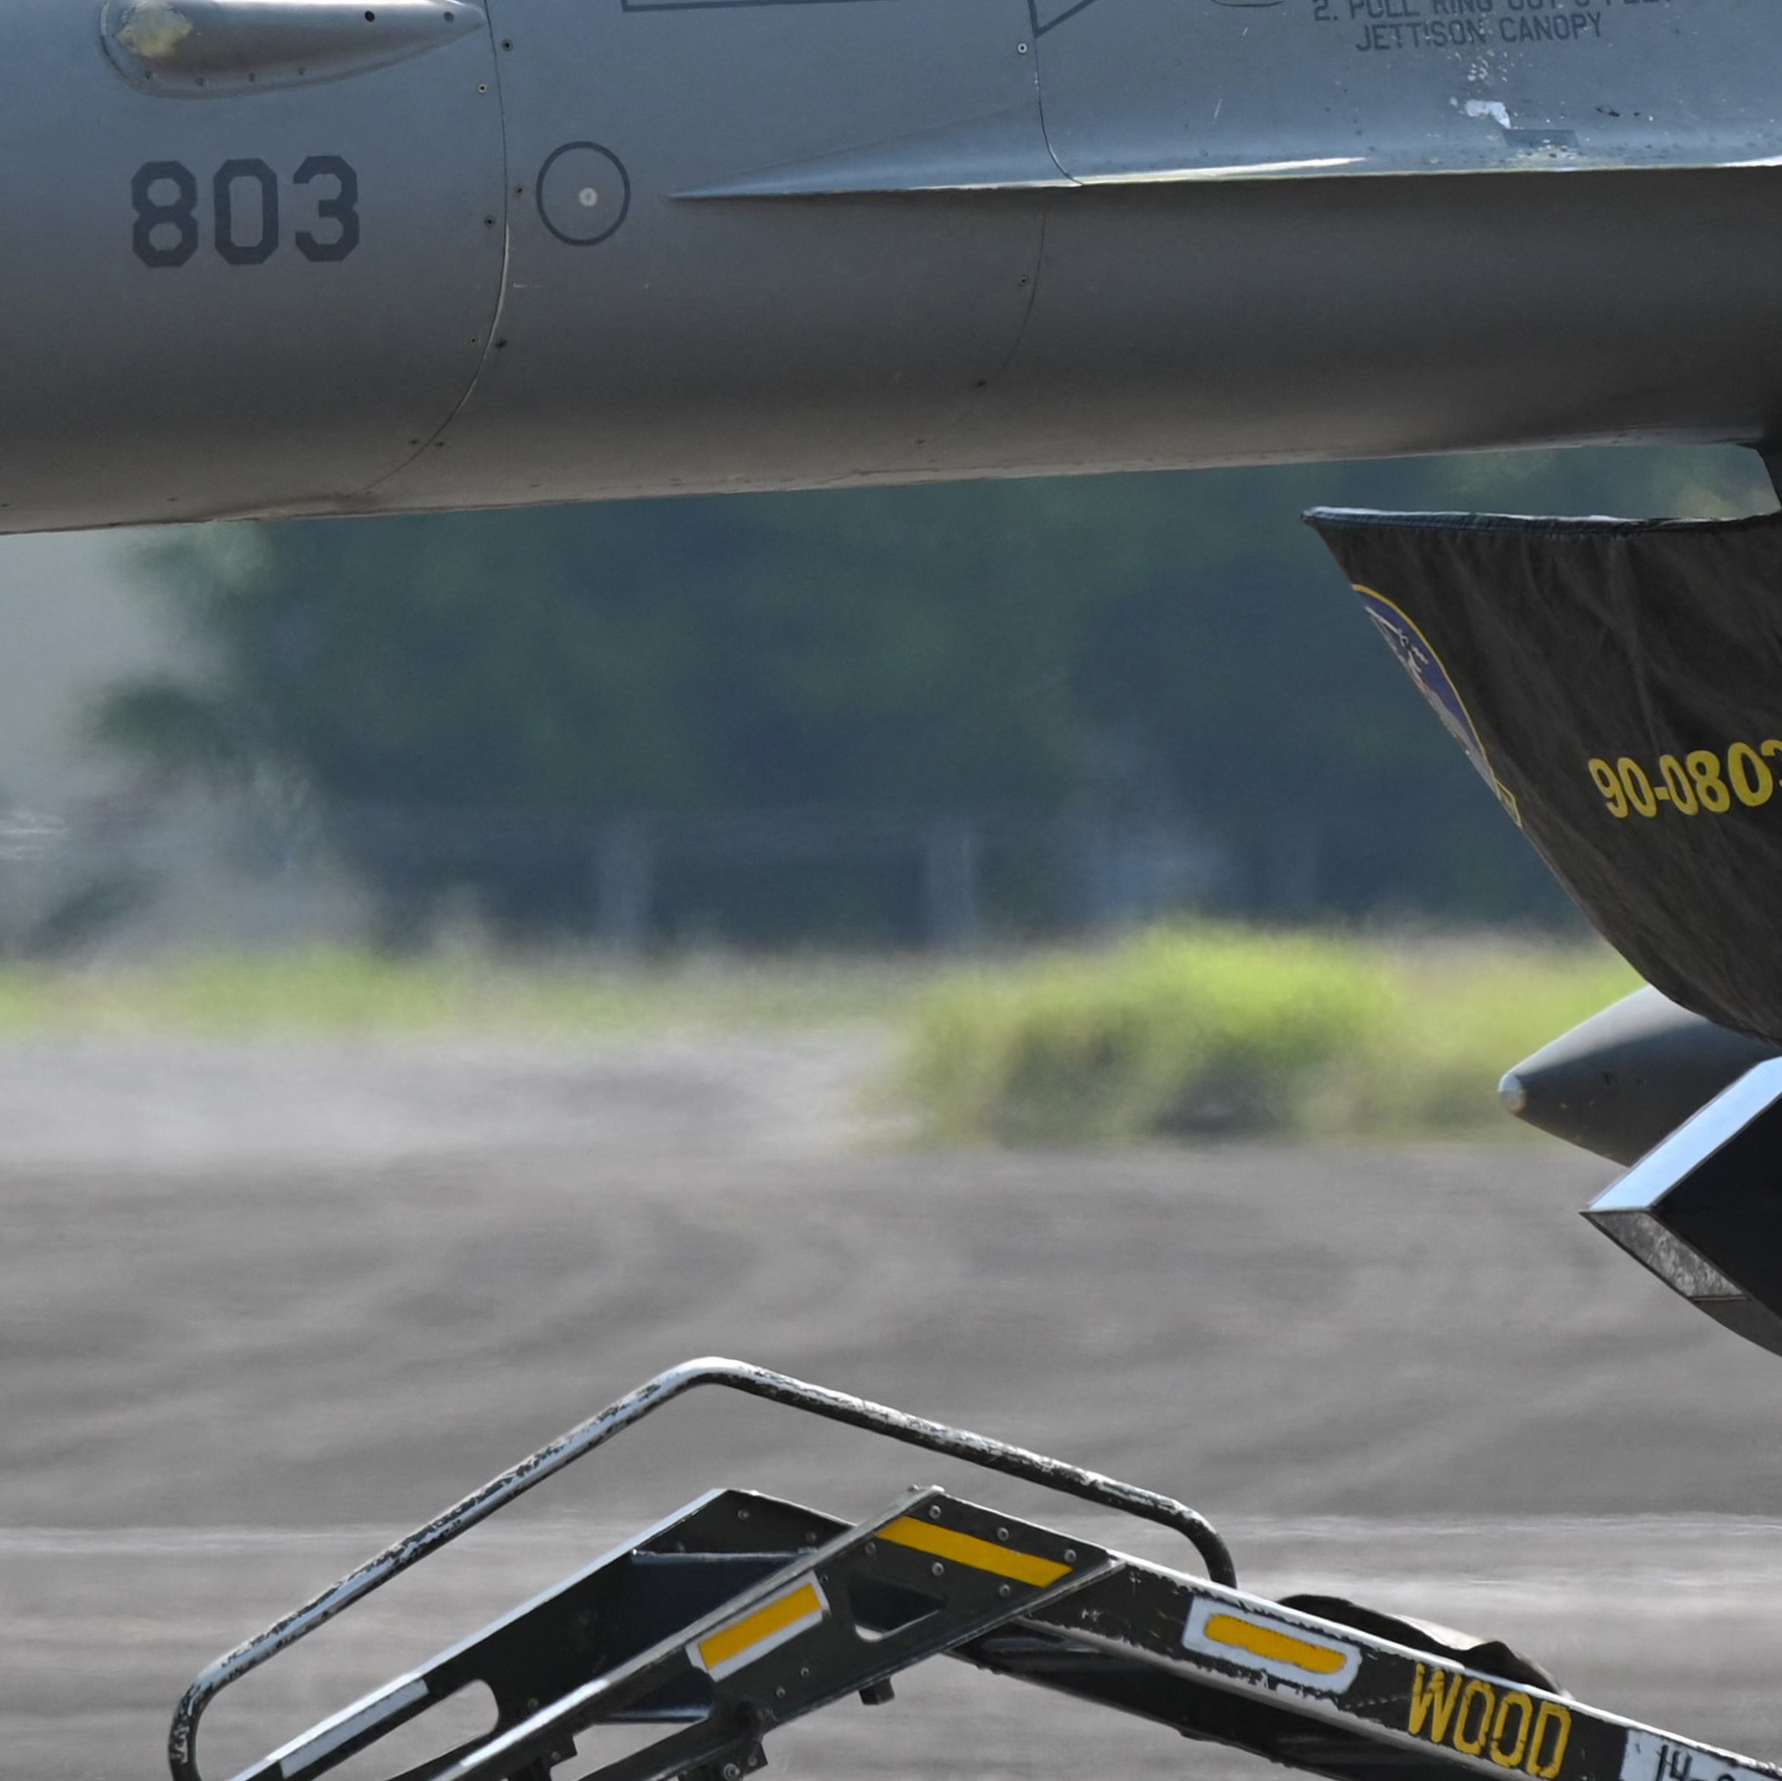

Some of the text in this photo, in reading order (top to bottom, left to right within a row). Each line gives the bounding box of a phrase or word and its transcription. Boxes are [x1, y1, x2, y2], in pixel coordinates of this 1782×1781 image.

[1355, 12, 1602, 51] JETTISON CANOPY
[131, 154, 360, 268] 803
[1409, 1662, 1573, 1780] WOOD
